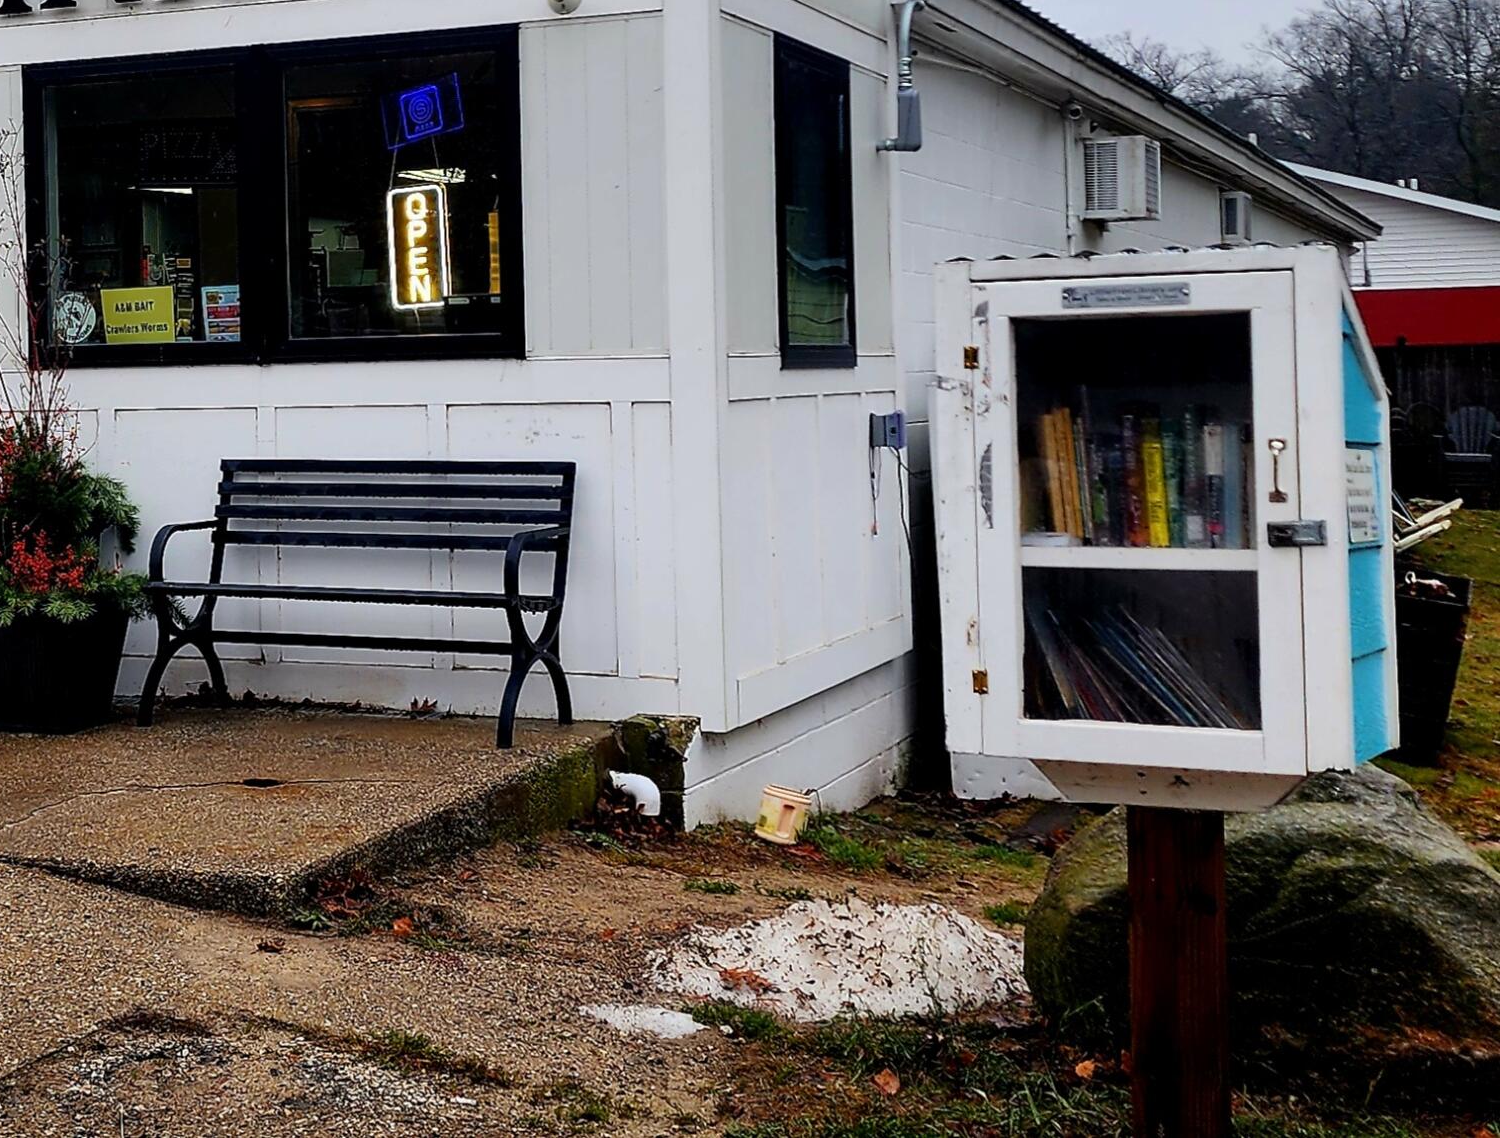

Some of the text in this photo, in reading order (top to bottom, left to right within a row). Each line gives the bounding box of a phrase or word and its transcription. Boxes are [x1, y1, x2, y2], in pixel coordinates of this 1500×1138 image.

[405, 192, 432, 302] OPEN
[115, 301, 155, 313] A&M BAIT
[106, 322, 168, 334] Crawlers Worms
